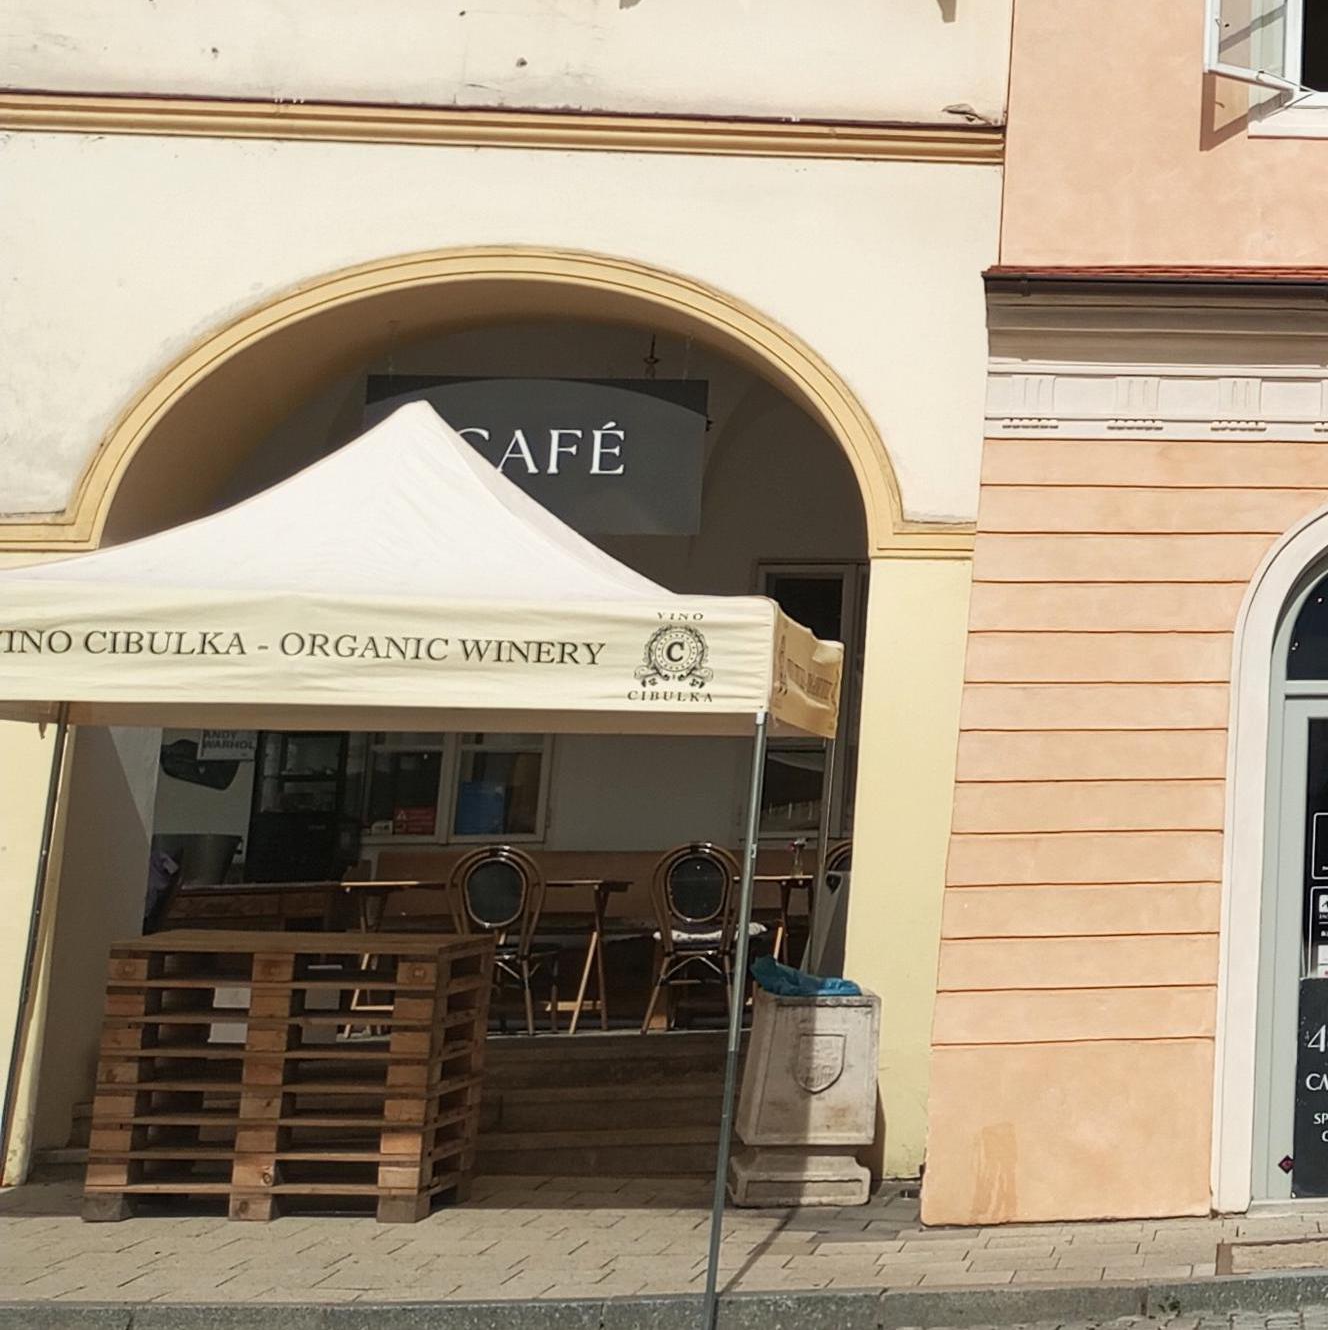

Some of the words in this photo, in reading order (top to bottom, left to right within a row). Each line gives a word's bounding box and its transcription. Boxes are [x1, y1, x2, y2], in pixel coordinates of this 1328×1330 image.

[656, 611, 704, 622] VINO
[83, 630, 248, 656] CIBULKA
[280, 631, 449, 662] ORGANIC
[458, 637, 606, 666] WINERY
[626, 689, 714, 703] CIBULKA
